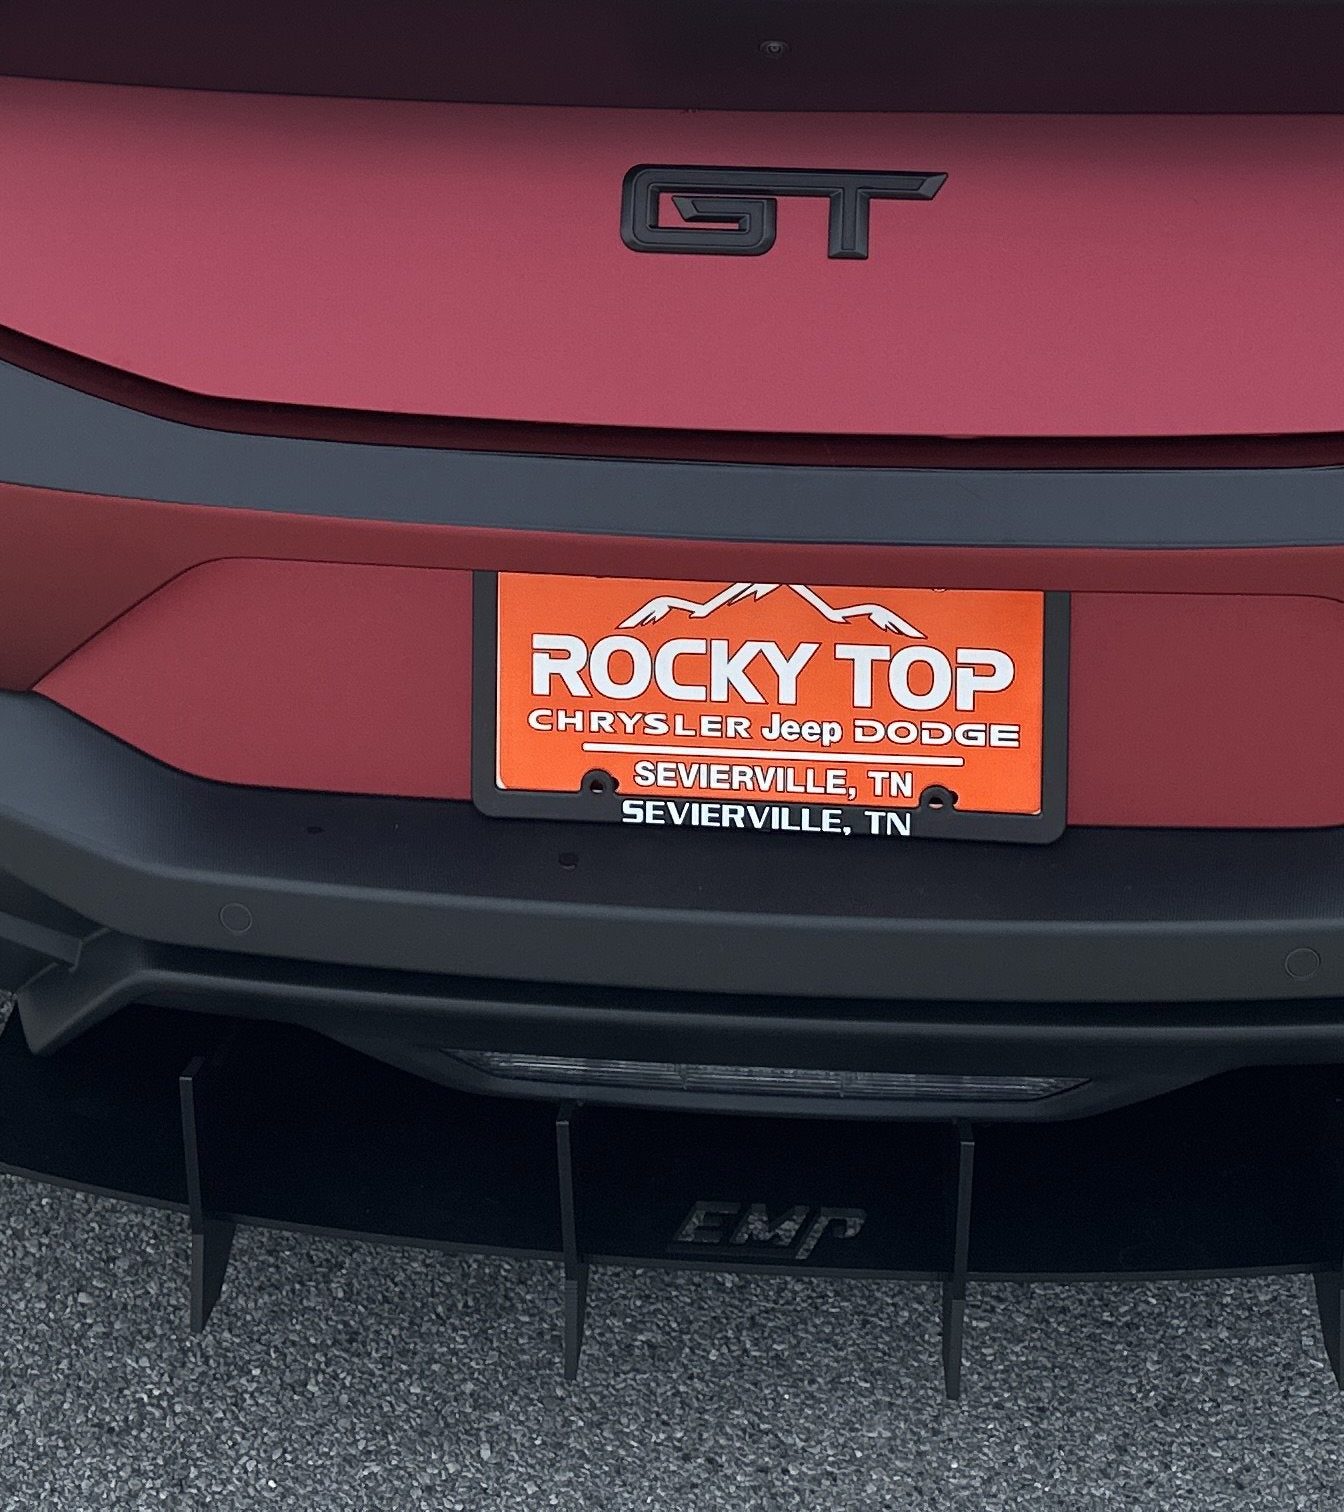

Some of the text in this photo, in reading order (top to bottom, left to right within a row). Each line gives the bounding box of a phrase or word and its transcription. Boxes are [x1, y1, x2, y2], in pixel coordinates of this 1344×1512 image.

[620, 163, 949, 260] GT
[531, 634, 1015, 713] ROCKY TOP
[527, 708, 1021, 748] CHRYSLER Jeep DODGE
[633, 759, 913, 801] SEVIERVILLE, TN
[621, 799, 911, 836] SEVIERVILLE, TN
[674, 1200, 868, 1260] EMP
